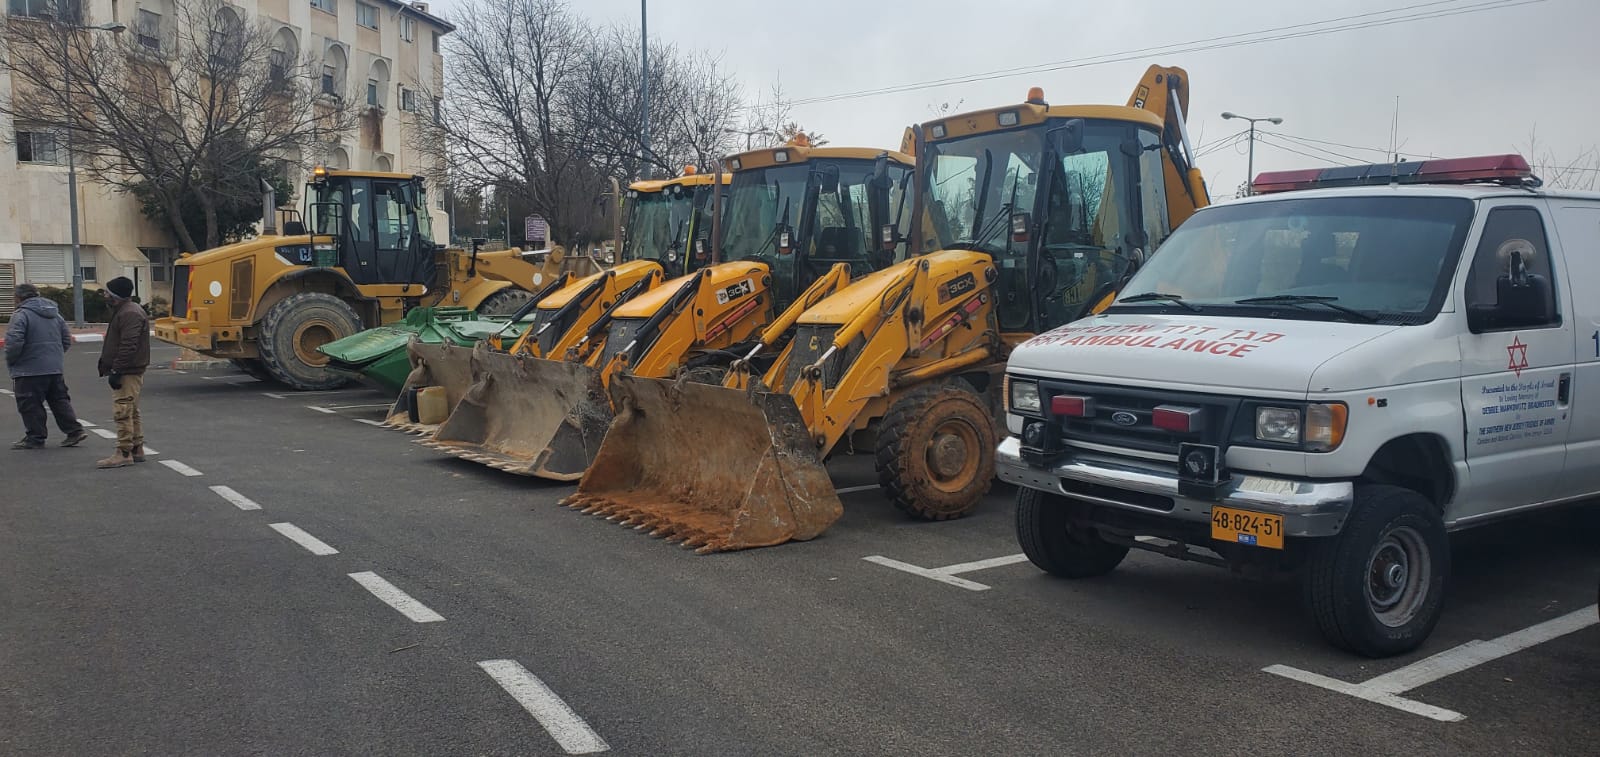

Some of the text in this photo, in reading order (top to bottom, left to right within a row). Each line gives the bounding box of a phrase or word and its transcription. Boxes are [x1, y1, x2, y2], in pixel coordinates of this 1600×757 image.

[728, 281, 749, 296] 3CX
[951, 278, 974, 293] 3CX
[1163, 325, 1217, 335] דוד
[1219, 330, 1286, 343] מגן
[1060, 335, 1260, 358] AMBULANCE
[1212, 510, 1281, 537] 48-824-51
